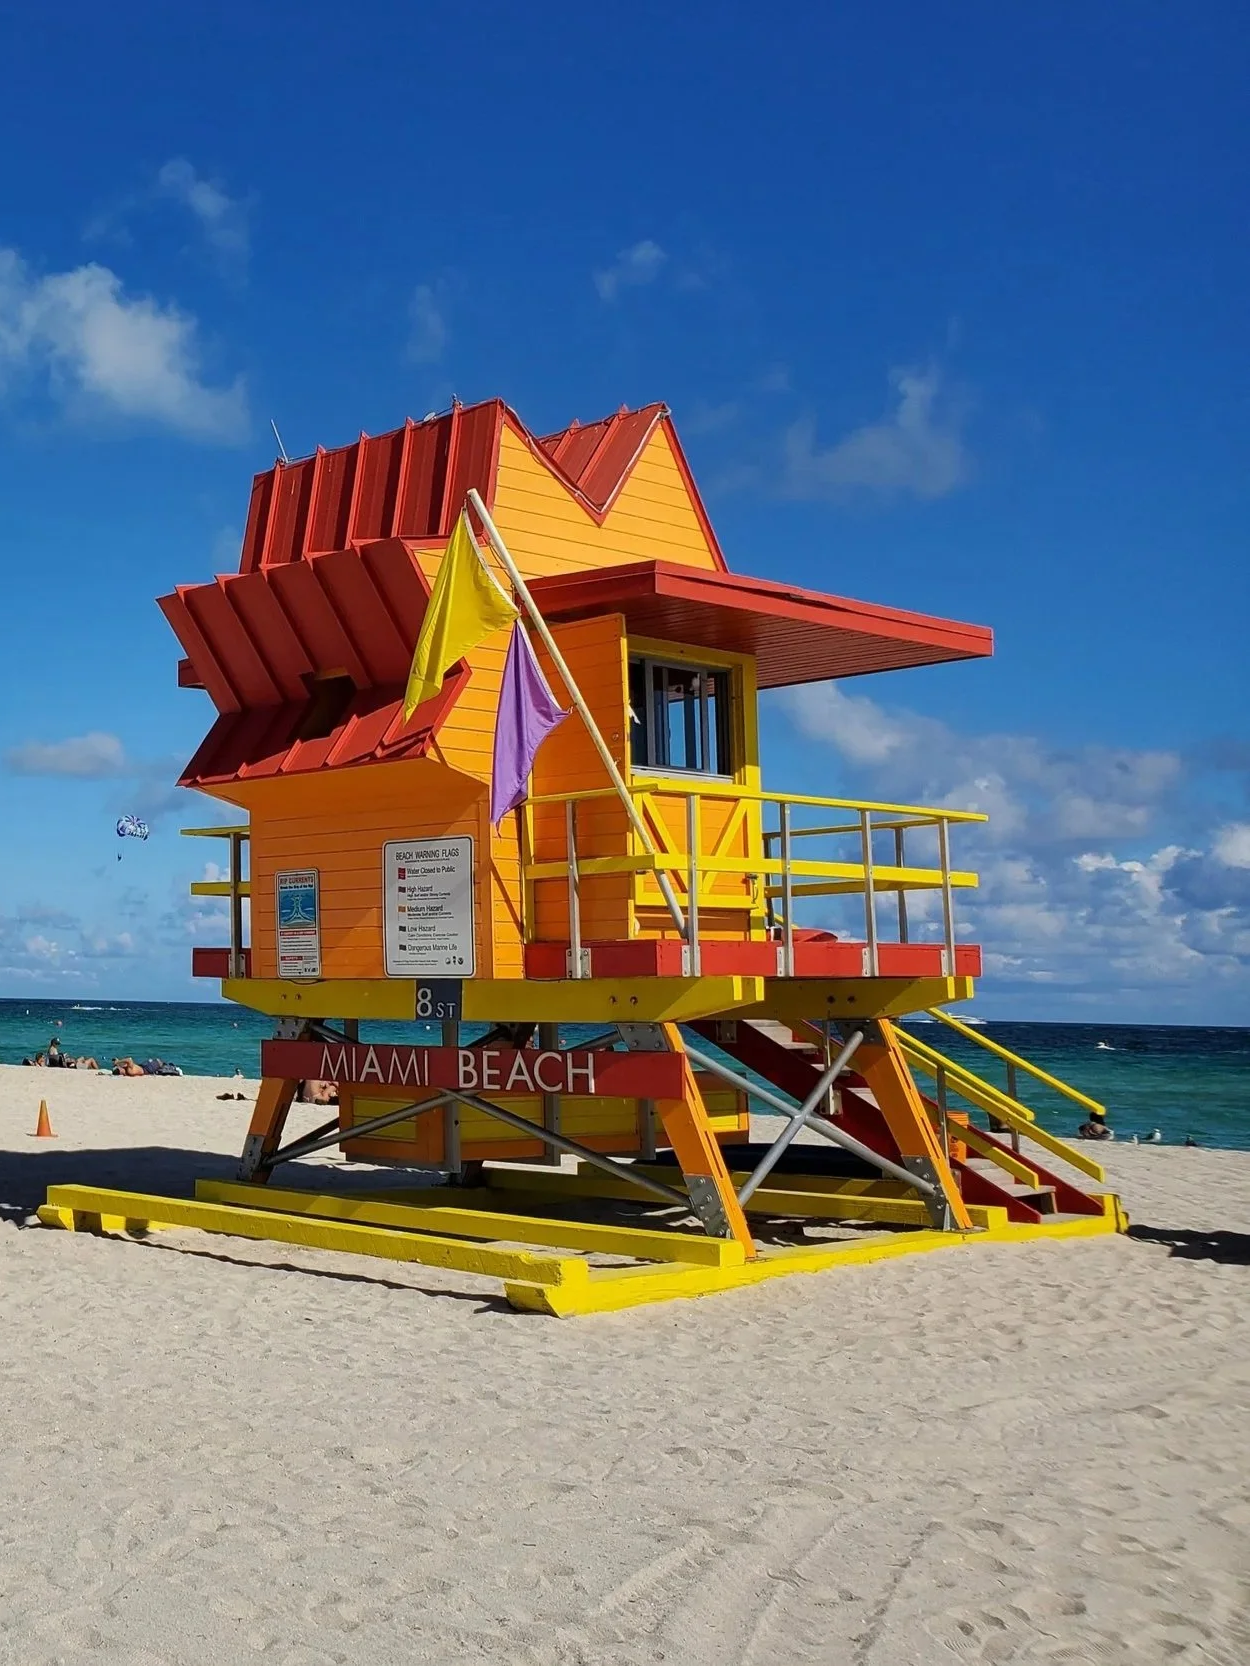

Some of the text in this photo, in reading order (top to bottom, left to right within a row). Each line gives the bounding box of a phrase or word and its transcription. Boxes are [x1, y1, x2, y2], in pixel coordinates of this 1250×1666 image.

[396, 848, 459, 860] BEACH WARNING FLAGS
[416, 988, 456, 1018] 8 ST
[319, 1044, 595, 1094] MIAMI BEACH
